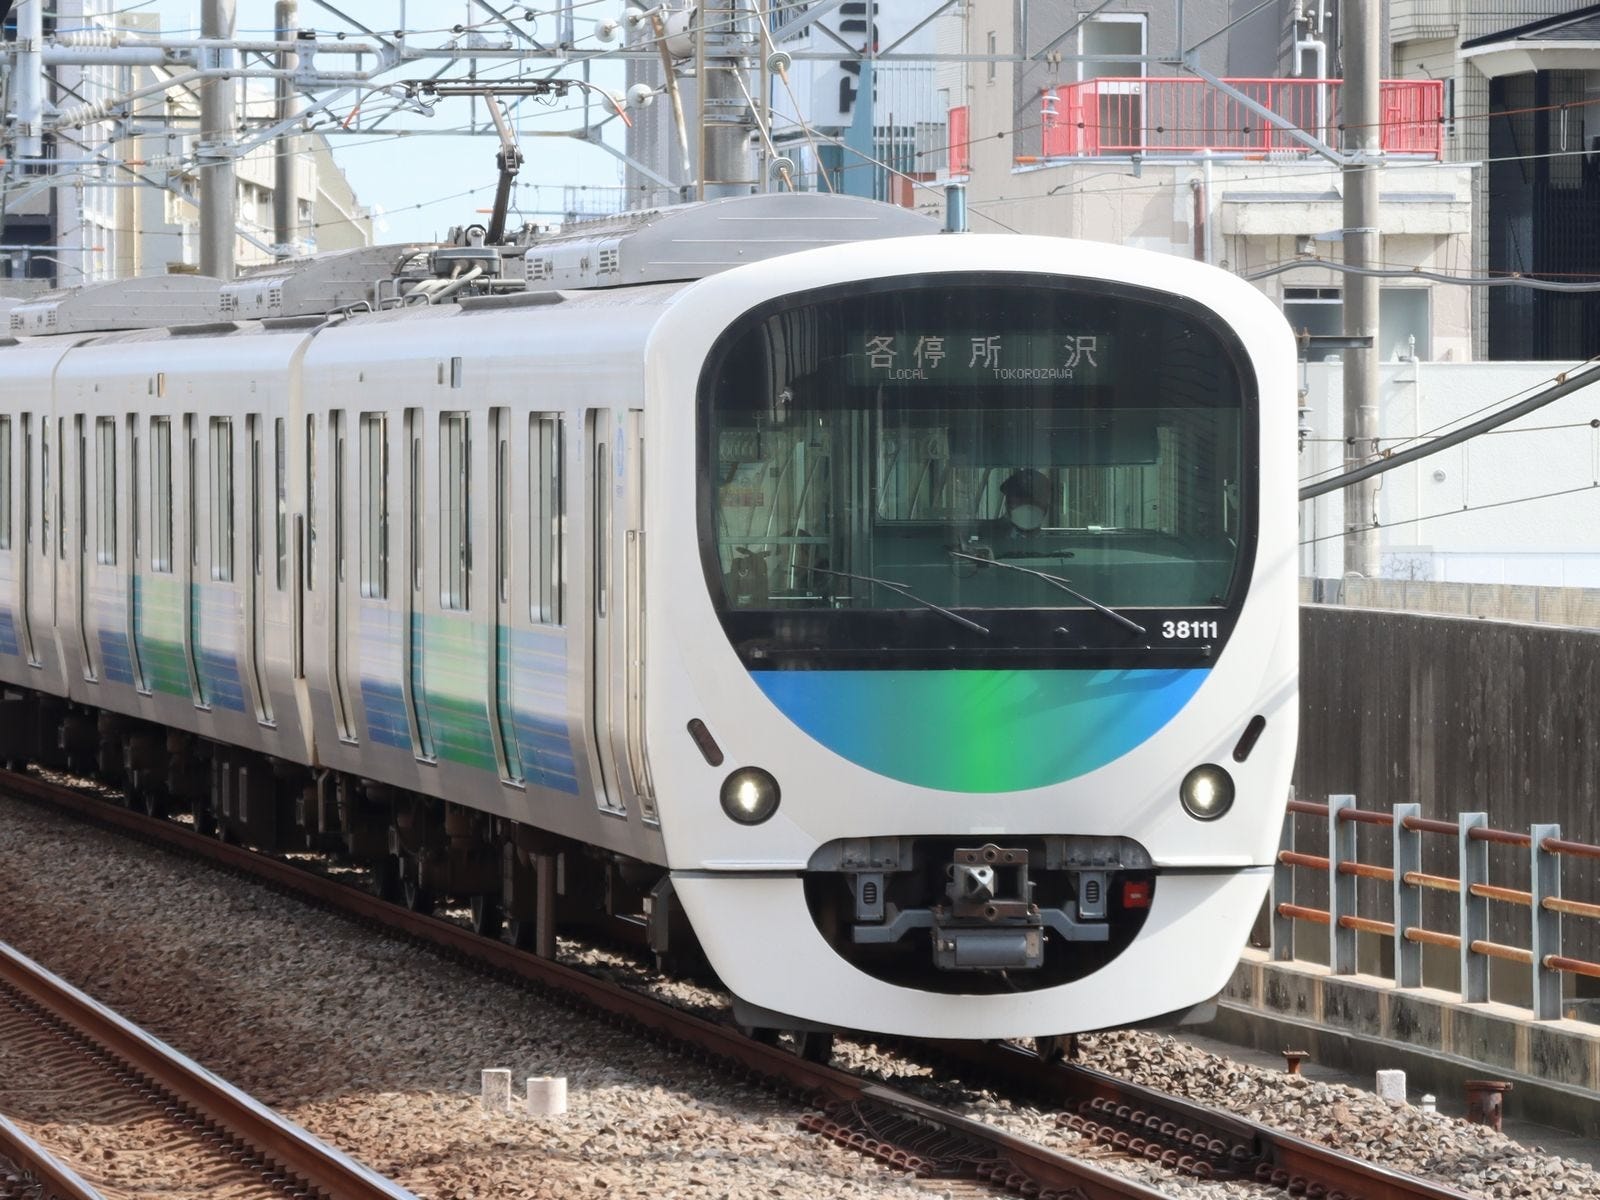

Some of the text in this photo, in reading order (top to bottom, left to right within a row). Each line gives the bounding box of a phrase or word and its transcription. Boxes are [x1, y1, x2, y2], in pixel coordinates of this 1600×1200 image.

[865, 335, 946, 369] 各停
[888, 368, 1073, 380] LOCAL TOKOROZAWA
[1161, 620, 1218, 639] 38111
